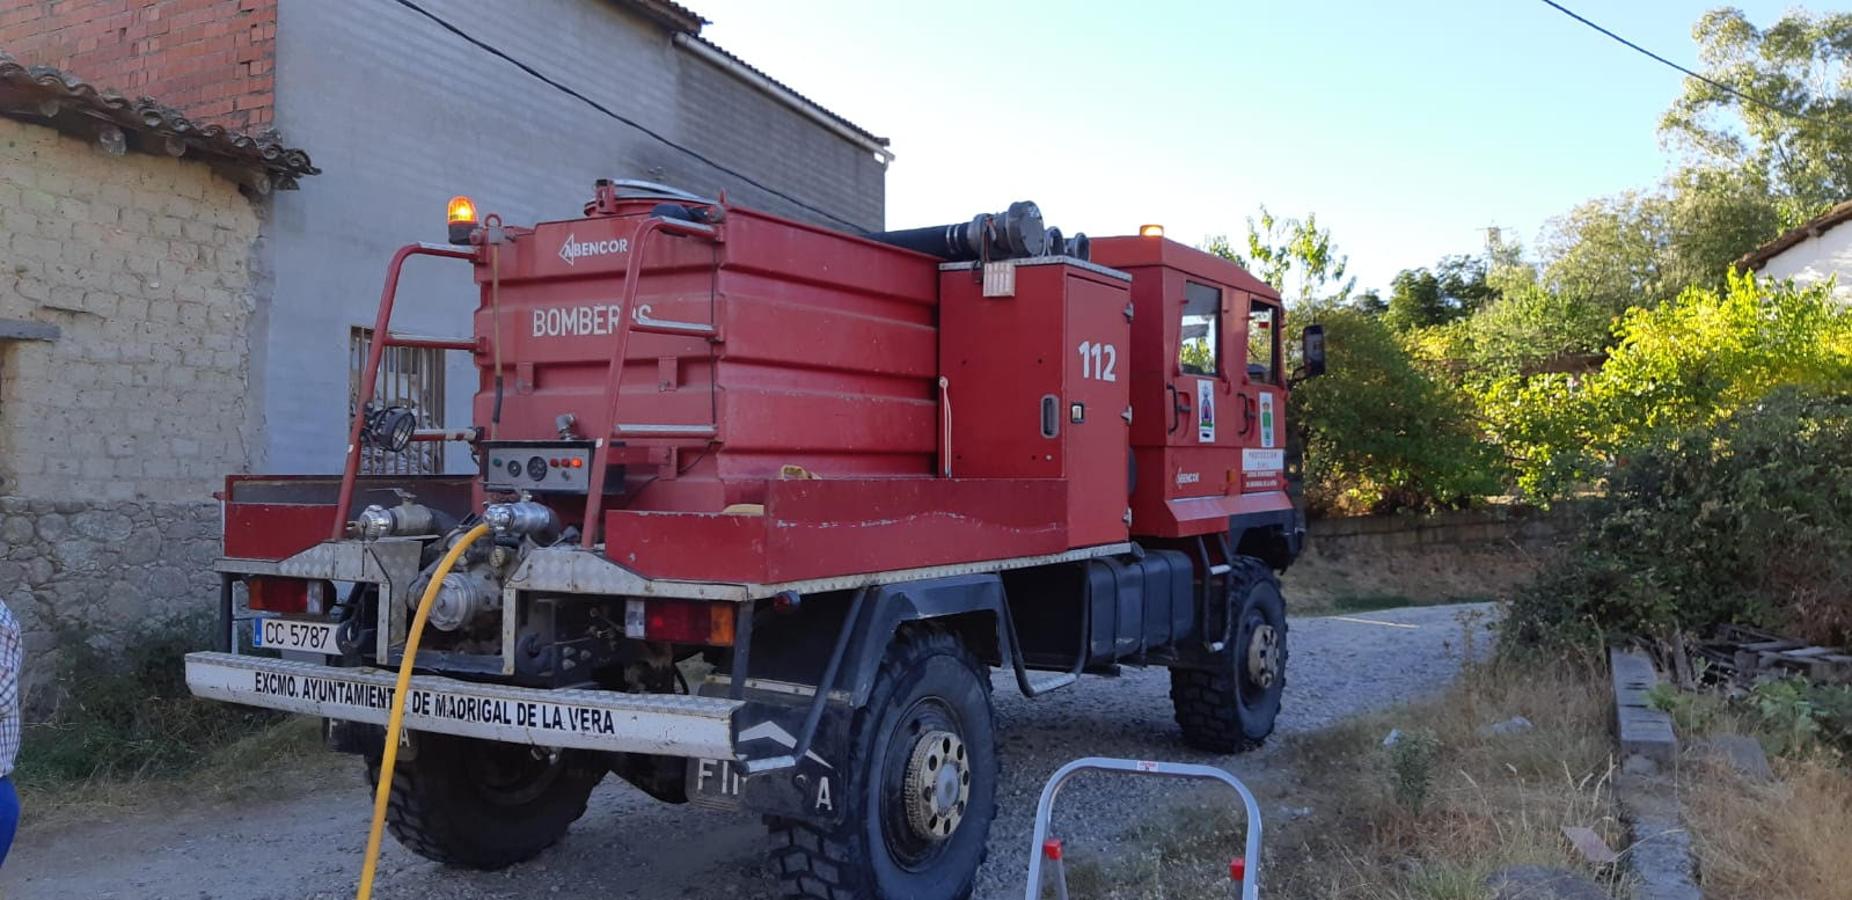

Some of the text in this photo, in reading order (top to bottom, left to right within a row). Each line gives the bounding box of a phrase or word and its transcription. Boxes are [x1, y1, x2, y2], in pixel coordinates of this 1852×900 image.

[532, 303, 652, 337] BOMBERS
[1078, 340, 1117, 382] 112
[265, 622, 330, 649] CC 5787
[255, 672, 615, 735] EXCMO. AYUNTAMIENT DE MADRIGAL DE LA VERA
